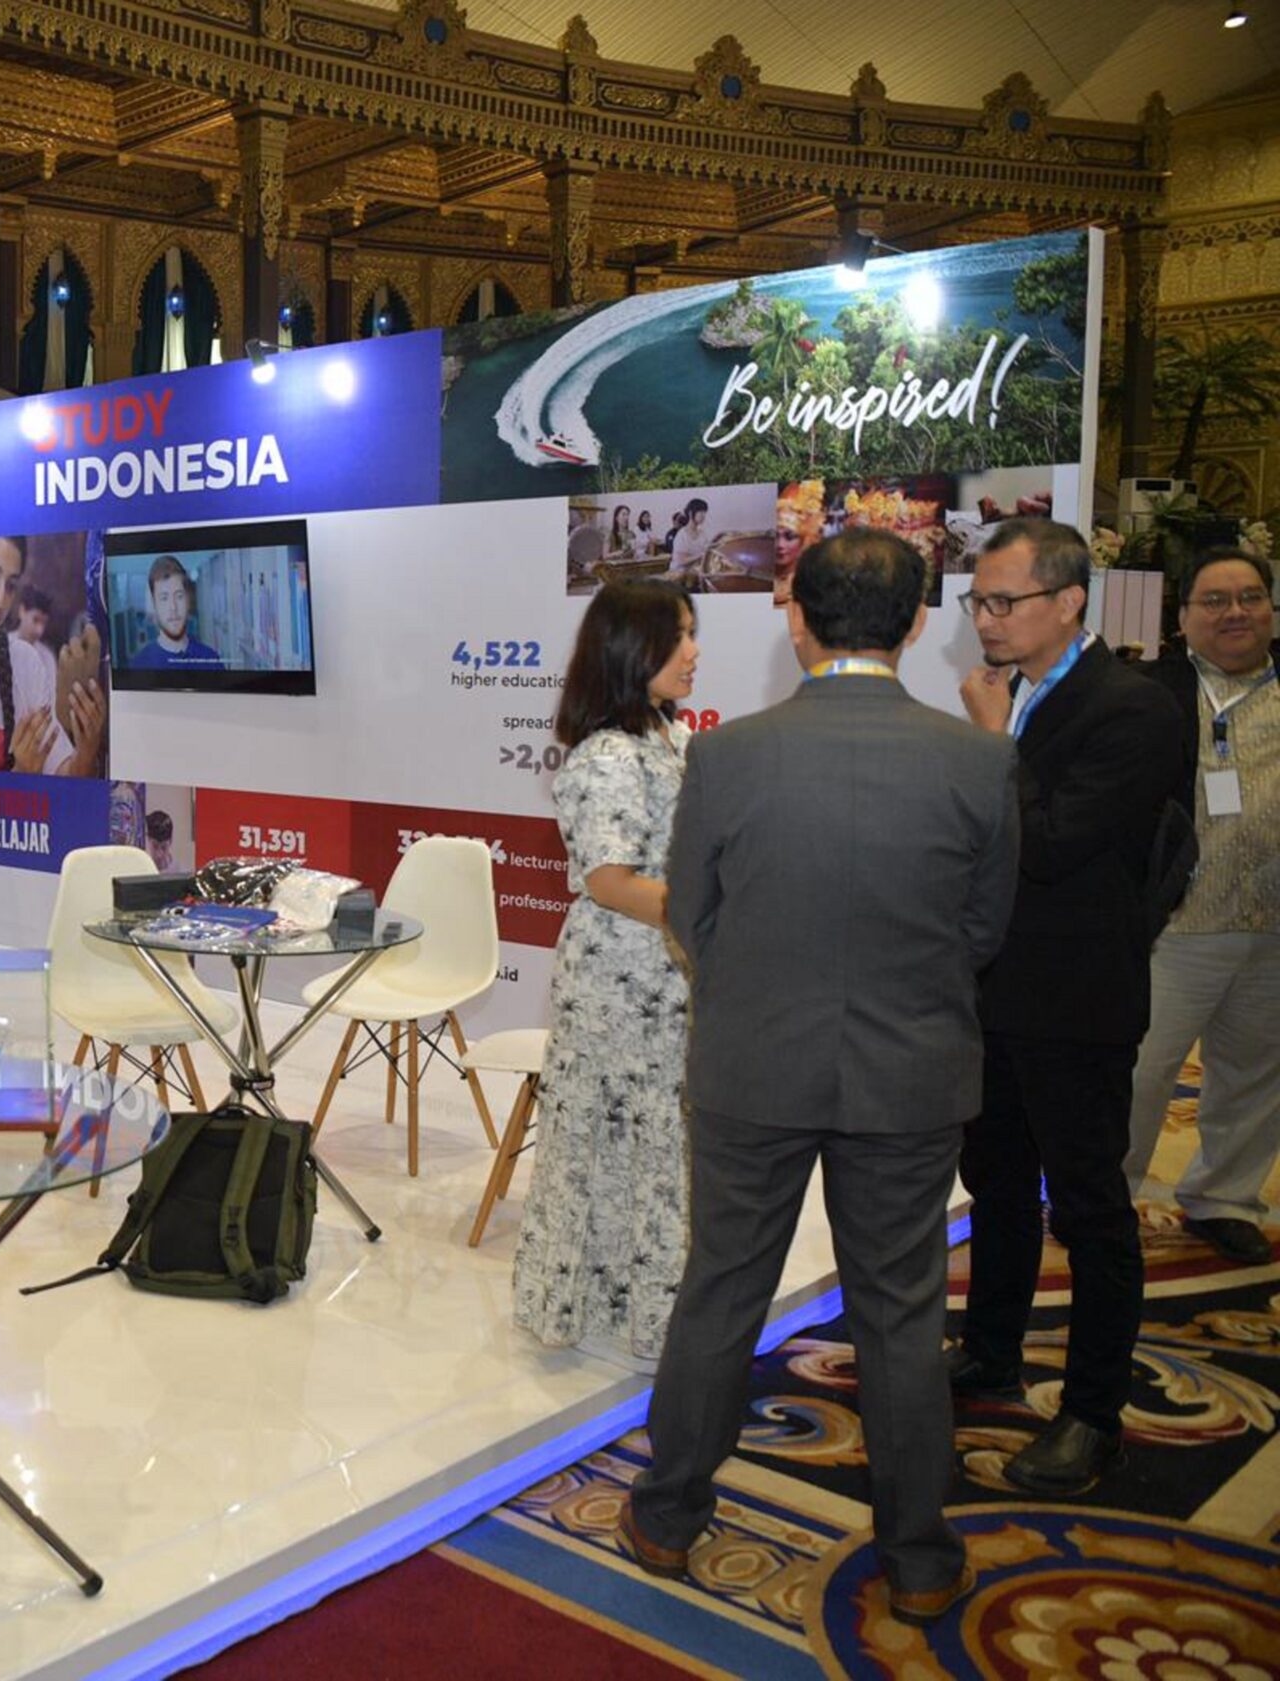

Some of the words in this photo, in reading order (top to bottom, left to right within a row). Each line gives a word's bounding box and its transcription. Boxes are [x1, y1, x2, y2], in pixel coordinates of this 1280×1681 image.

[702, 361, 782, 448] Be
[35, 434, 289, 506] INDONESIA
[452, 640, 541, 671] 4,522
[451, 672, 498, 689] higher
[503, 715, 554, 730] spread
[239, 825, 306, 855] 31,391
